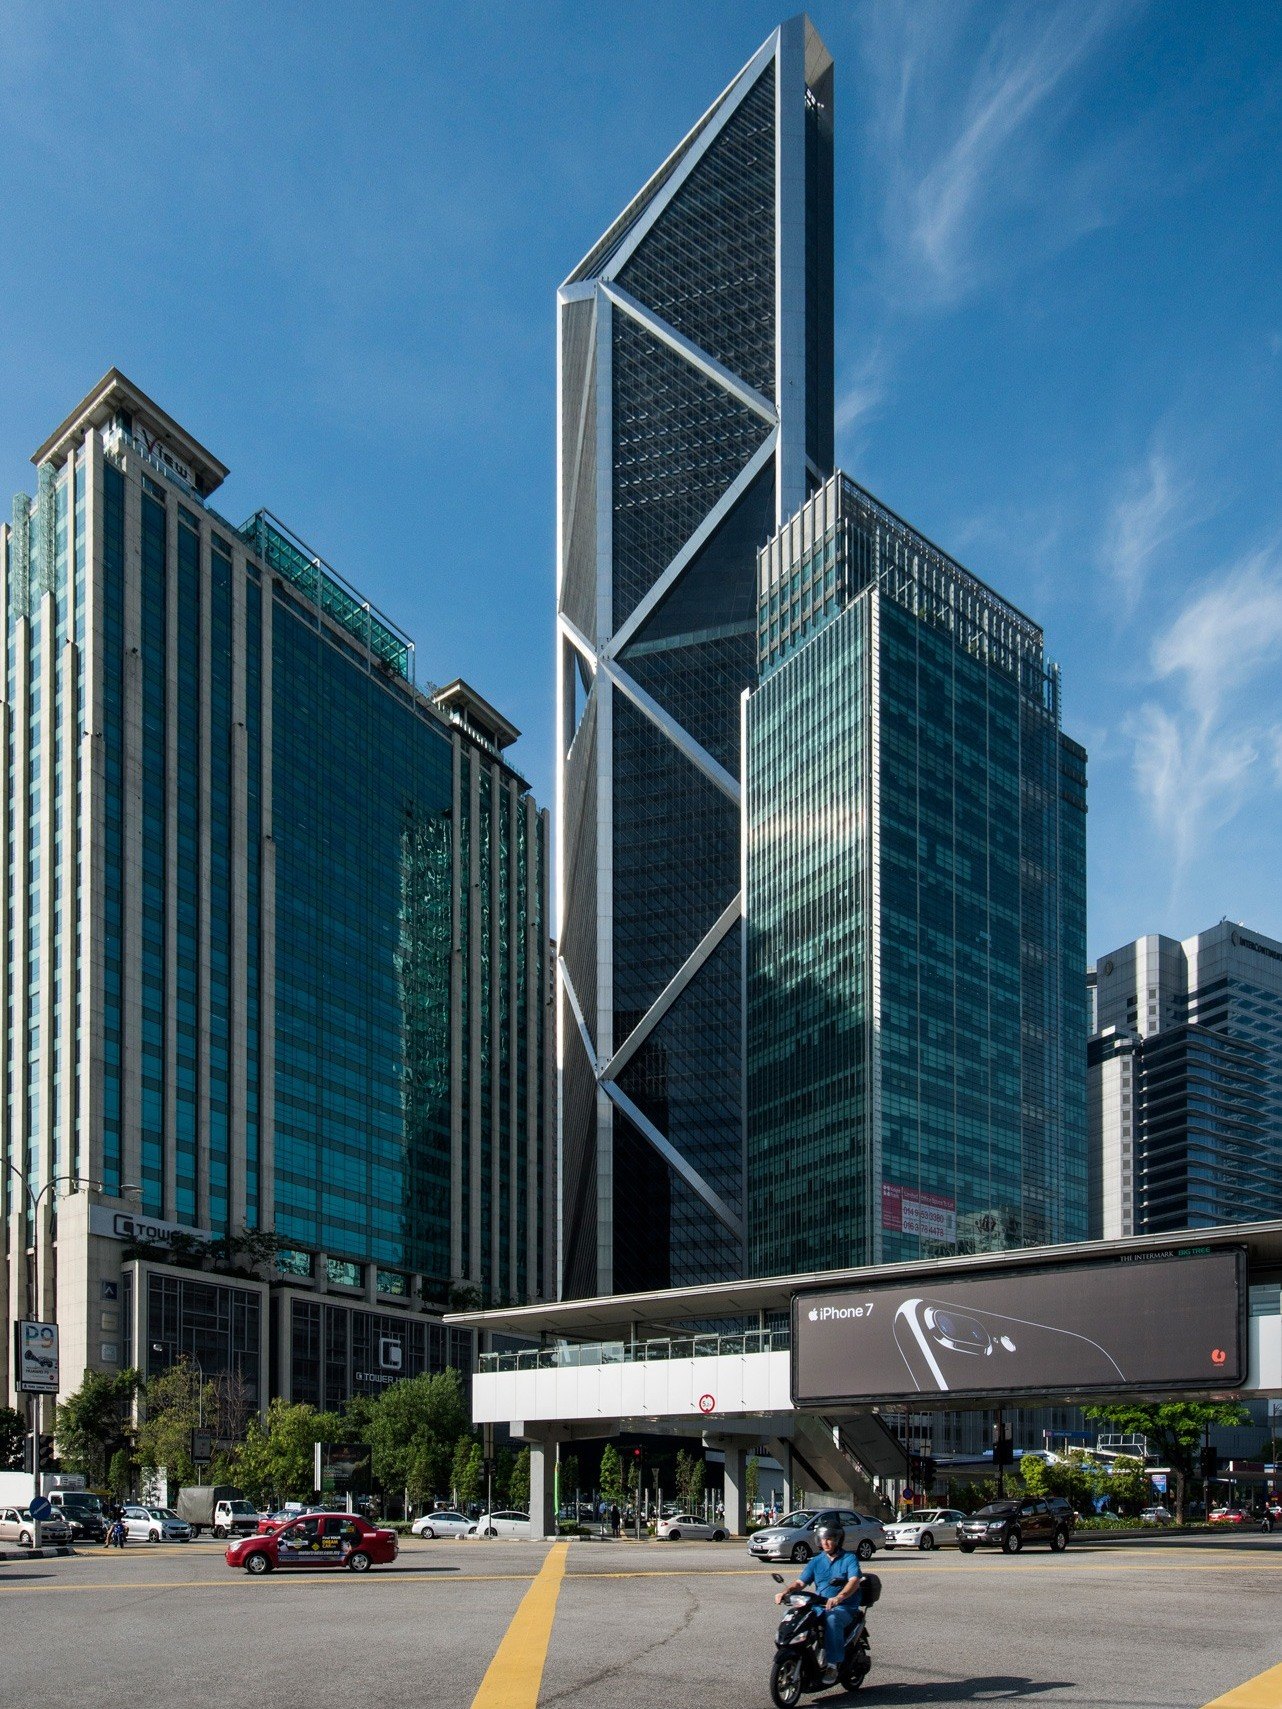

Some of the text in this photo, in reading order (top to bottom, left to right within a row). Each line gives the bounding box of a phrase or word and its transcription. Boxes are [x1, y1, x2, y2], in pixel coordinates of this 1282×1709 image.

[1134, 1251, 1174, 1261] INTERMARK
[820, 1303, 874, 1320] iPhone 7
[25, 1325, 54, 1348] P9
